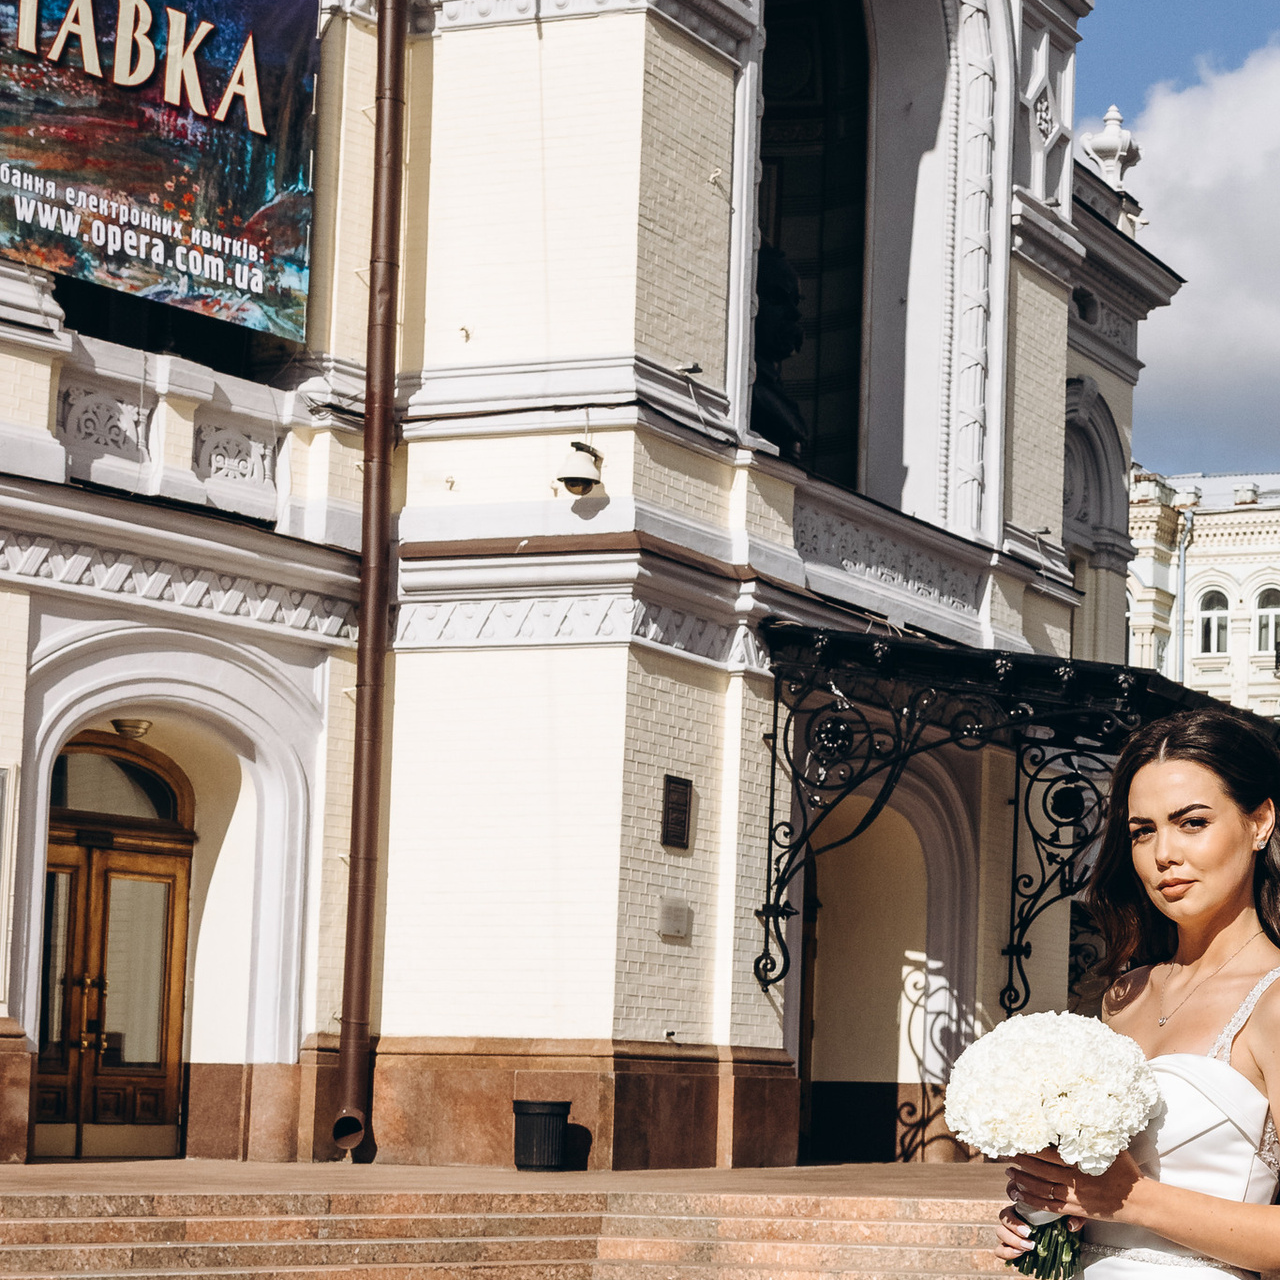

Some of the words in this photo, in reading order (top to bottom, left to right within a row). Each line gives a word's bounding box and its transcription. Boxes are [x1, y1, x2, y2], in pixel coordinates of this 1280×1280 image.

[14, 193, 264, 294] www.opera.com.ua
[65, 186, 183, 240] електронних
[191, 226, 265, 264] квитків:
